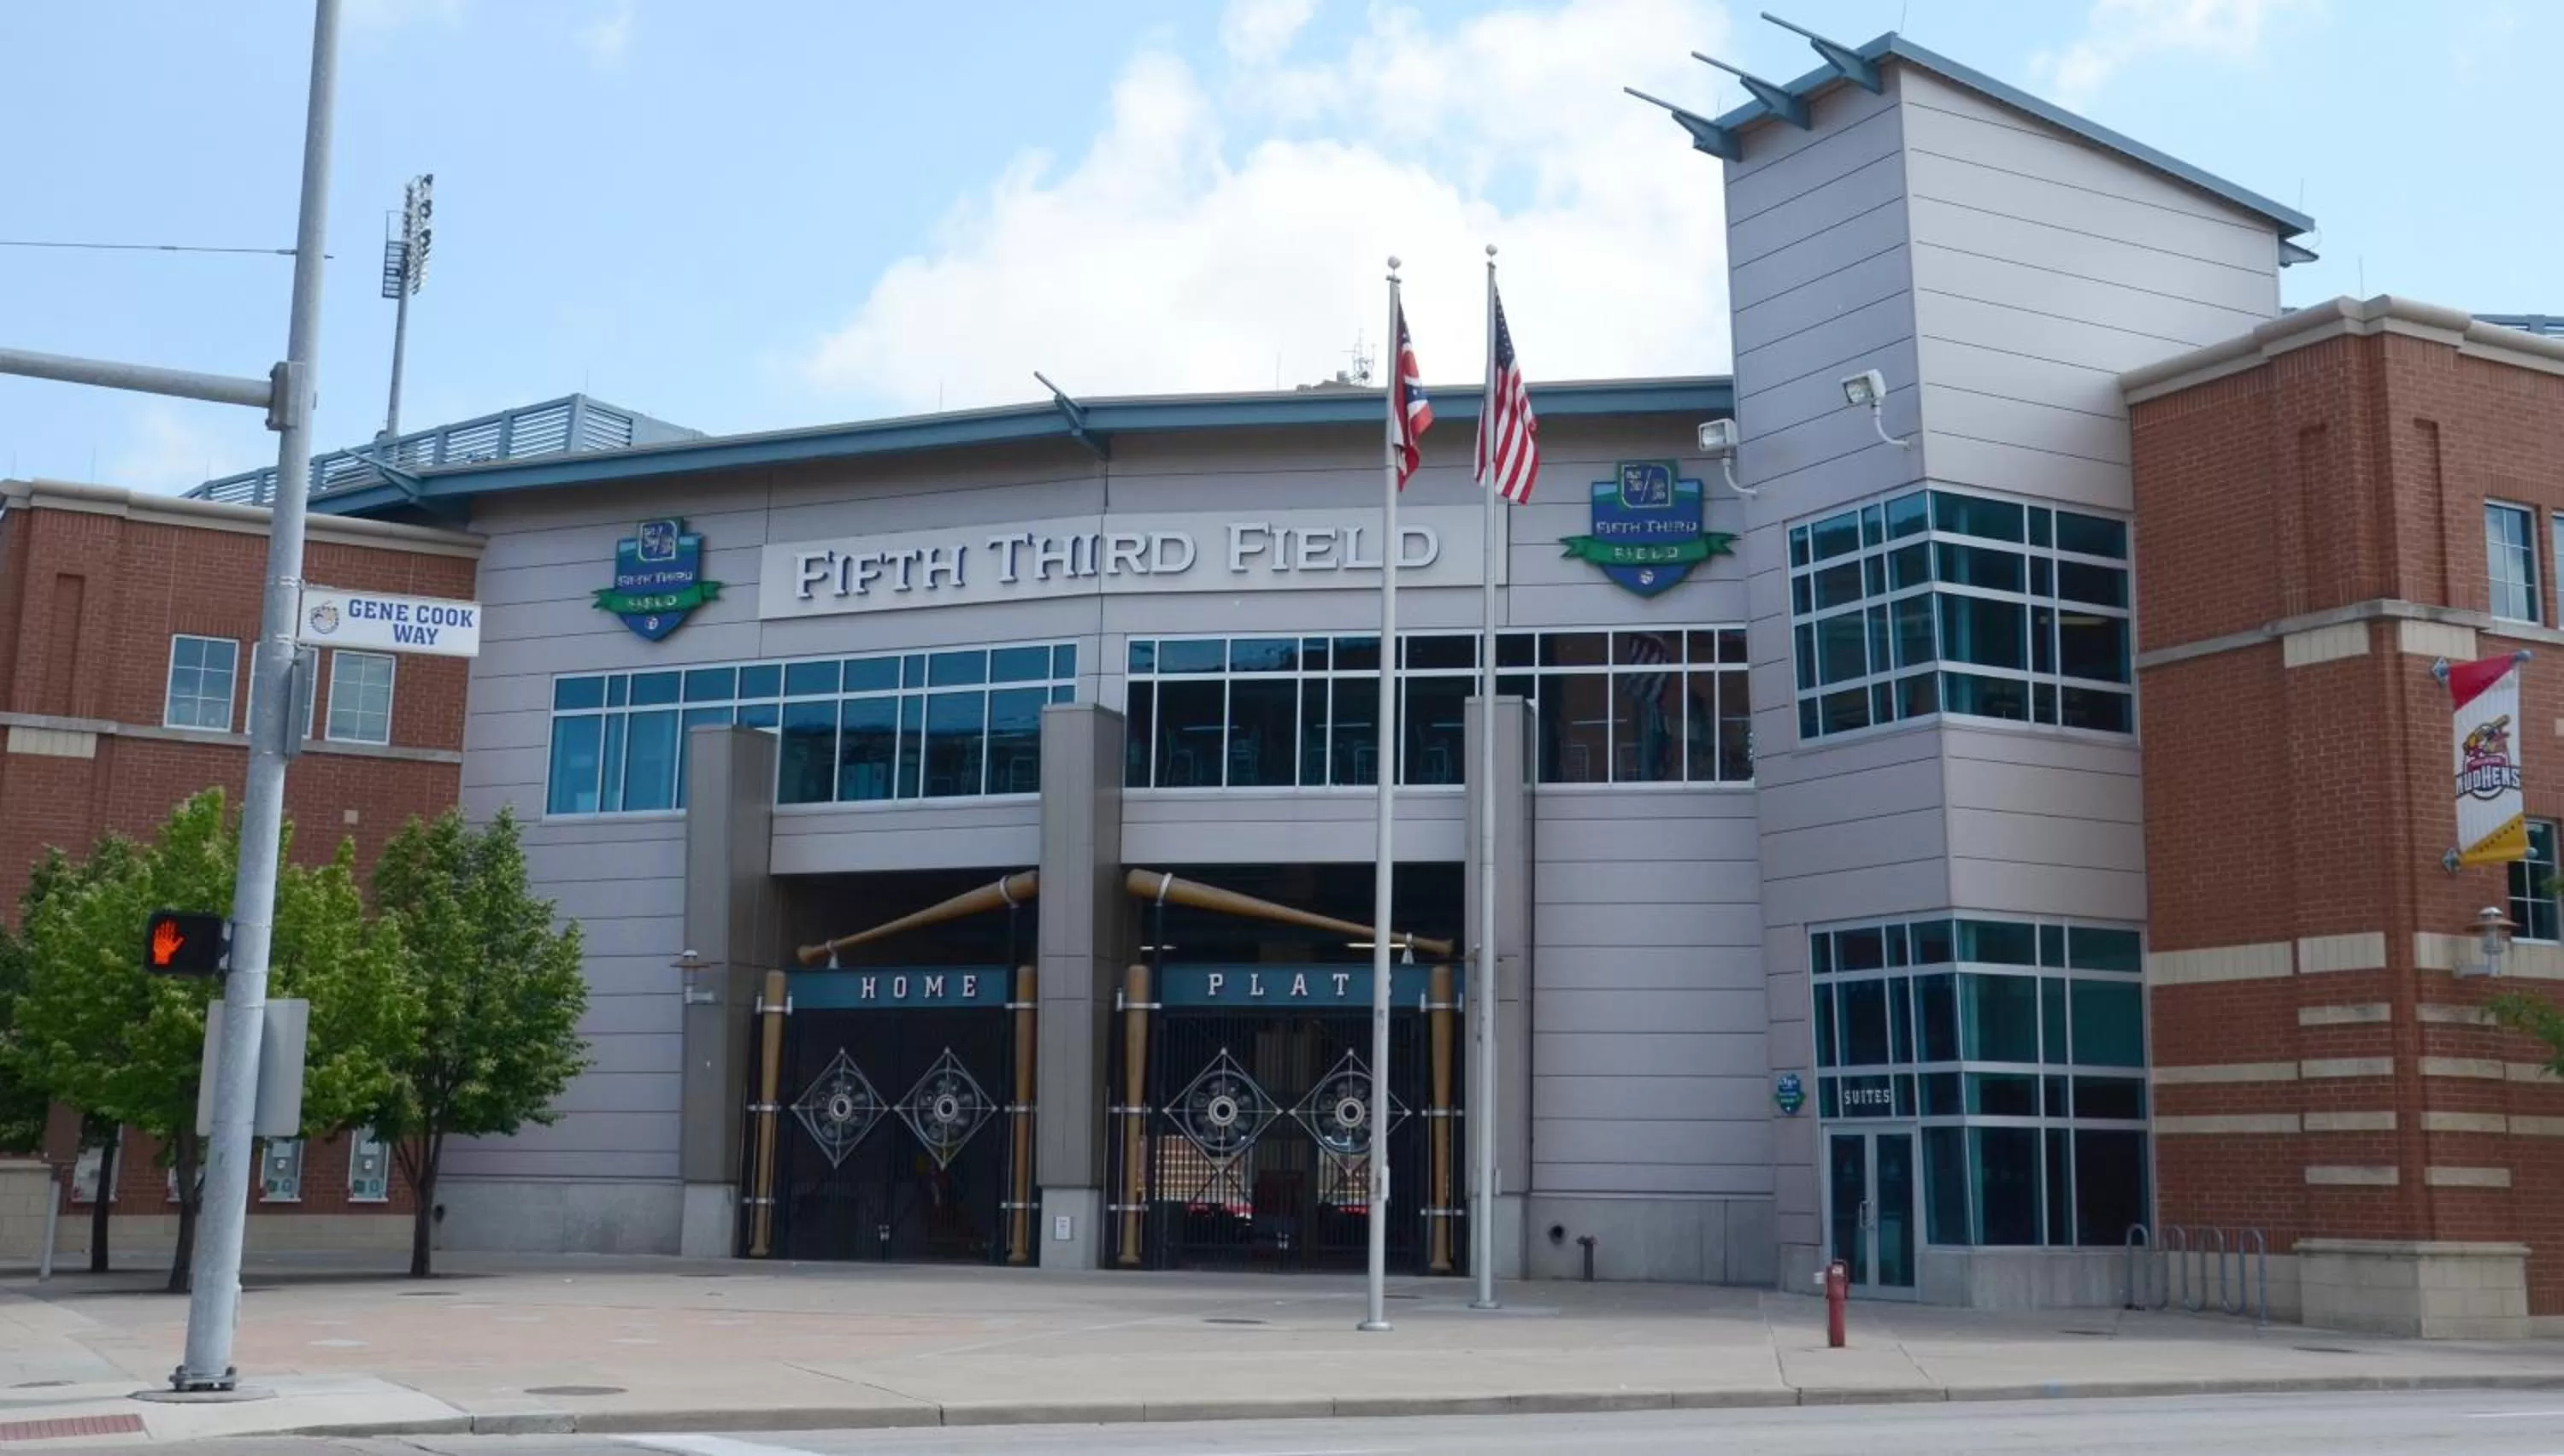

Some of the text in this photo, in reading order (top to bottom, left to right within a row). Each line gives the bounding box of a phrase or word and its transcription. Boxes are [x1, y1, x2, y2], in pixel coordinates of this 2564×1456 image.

[795, 521, 1439, 599] FIFTH THIRD FIELD
[348, 598, 474, 628] GENE COOK
[392, 623, 439, 645] WAY
[861, 974, 977, 999] HOME
[1207, 972, 1392, 996] PLAT
[1844, 1089, 1891, 1105] SUITES
